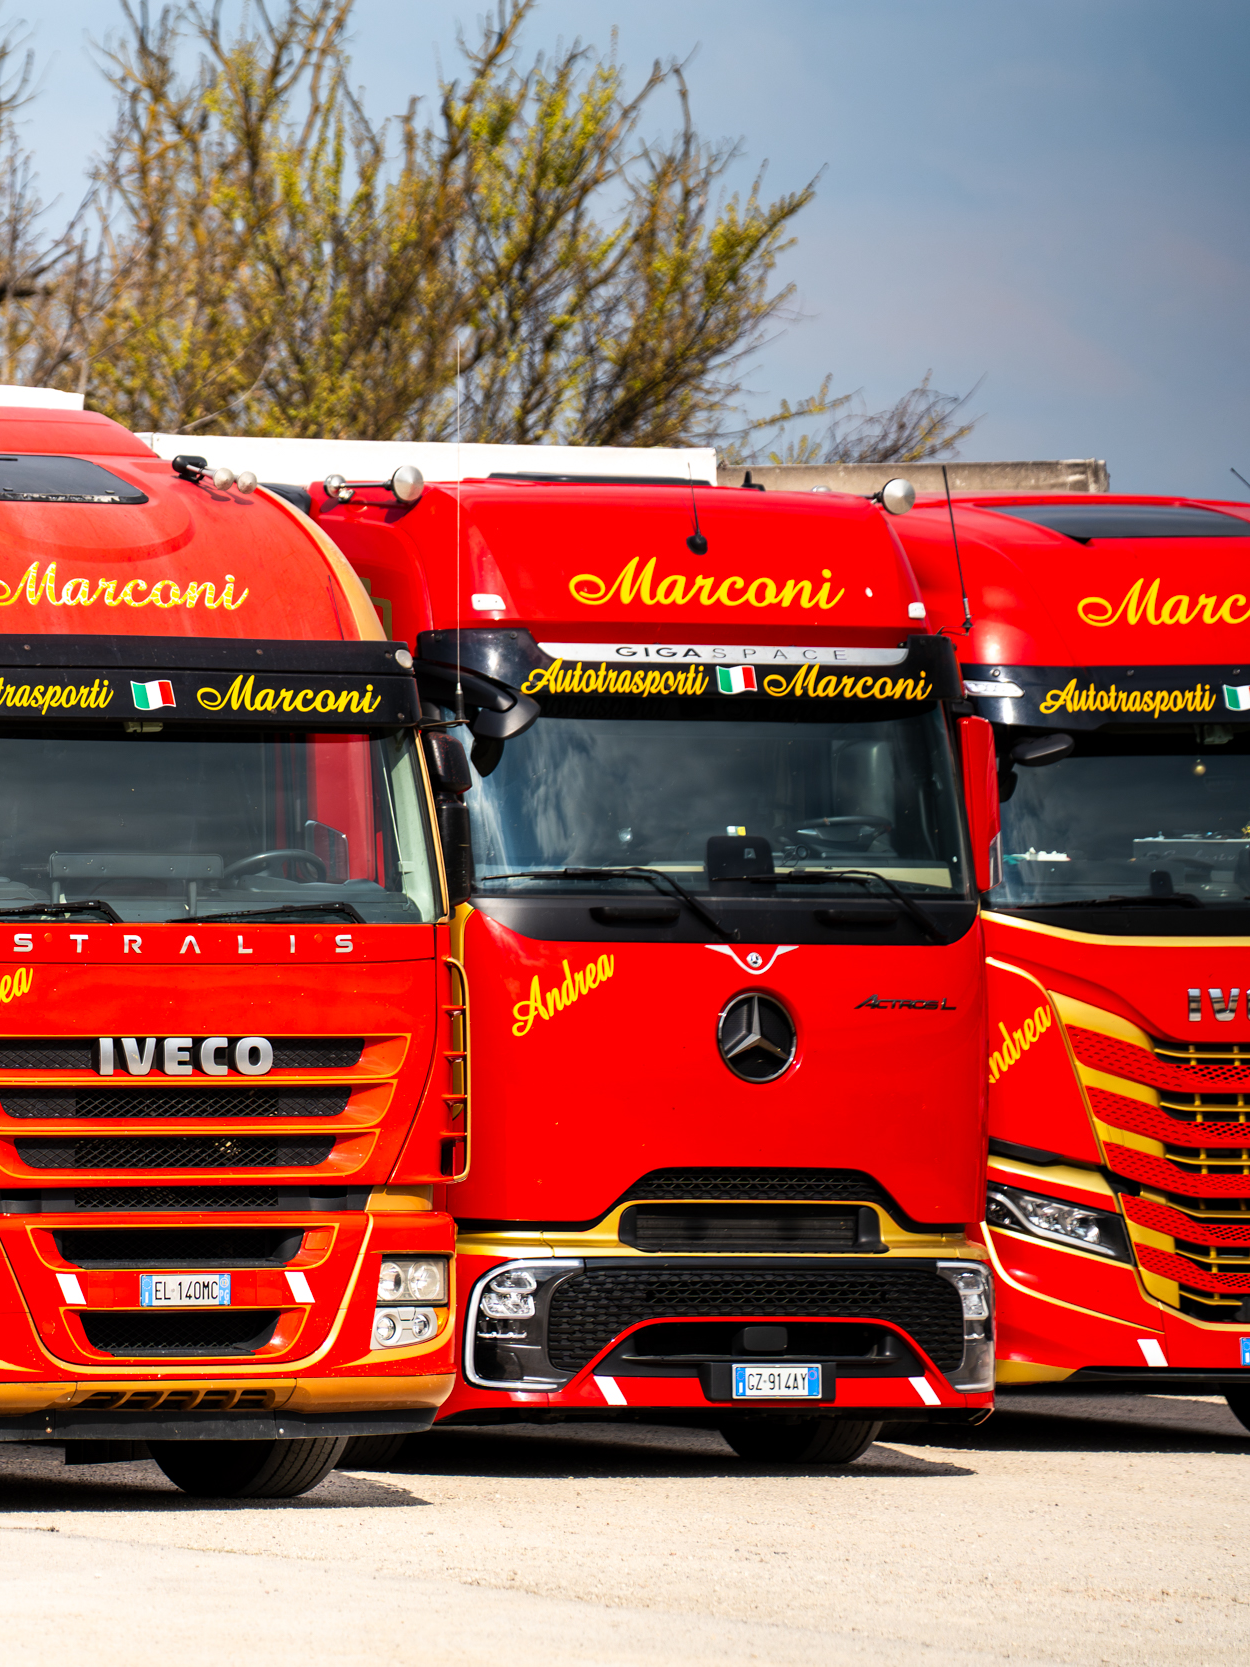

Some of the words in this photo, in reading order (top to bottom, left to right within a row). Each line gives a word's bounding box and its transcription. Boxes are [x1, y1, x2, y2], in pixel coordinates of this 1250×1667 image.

[568, 556, 845, 611] Marconi
[196, 674, 382, 714] Marconi
[520, 657, 710, 698] Autotrasporti
[763, 662, 933, 701] Marconi
[1039, 678, 1217, 719] Autotrasporti
[12, 933, 354, 954] STRALIS
[511, 953, 616, 1037] Andrea
[1187, 987, 1250, 1022] IV
[96, 1036, 275, 1077] IVECO
[988, 1003, 1052, 1084] ndrea
[154, 1281, 171, 1300] EL
[177, 1280, 219, 1300] 140MC
[219, 1289, 229, 1302] PG
[747, 1373, 763, 1391] GZ
[768, 1372, 807, 1391] 914AY
